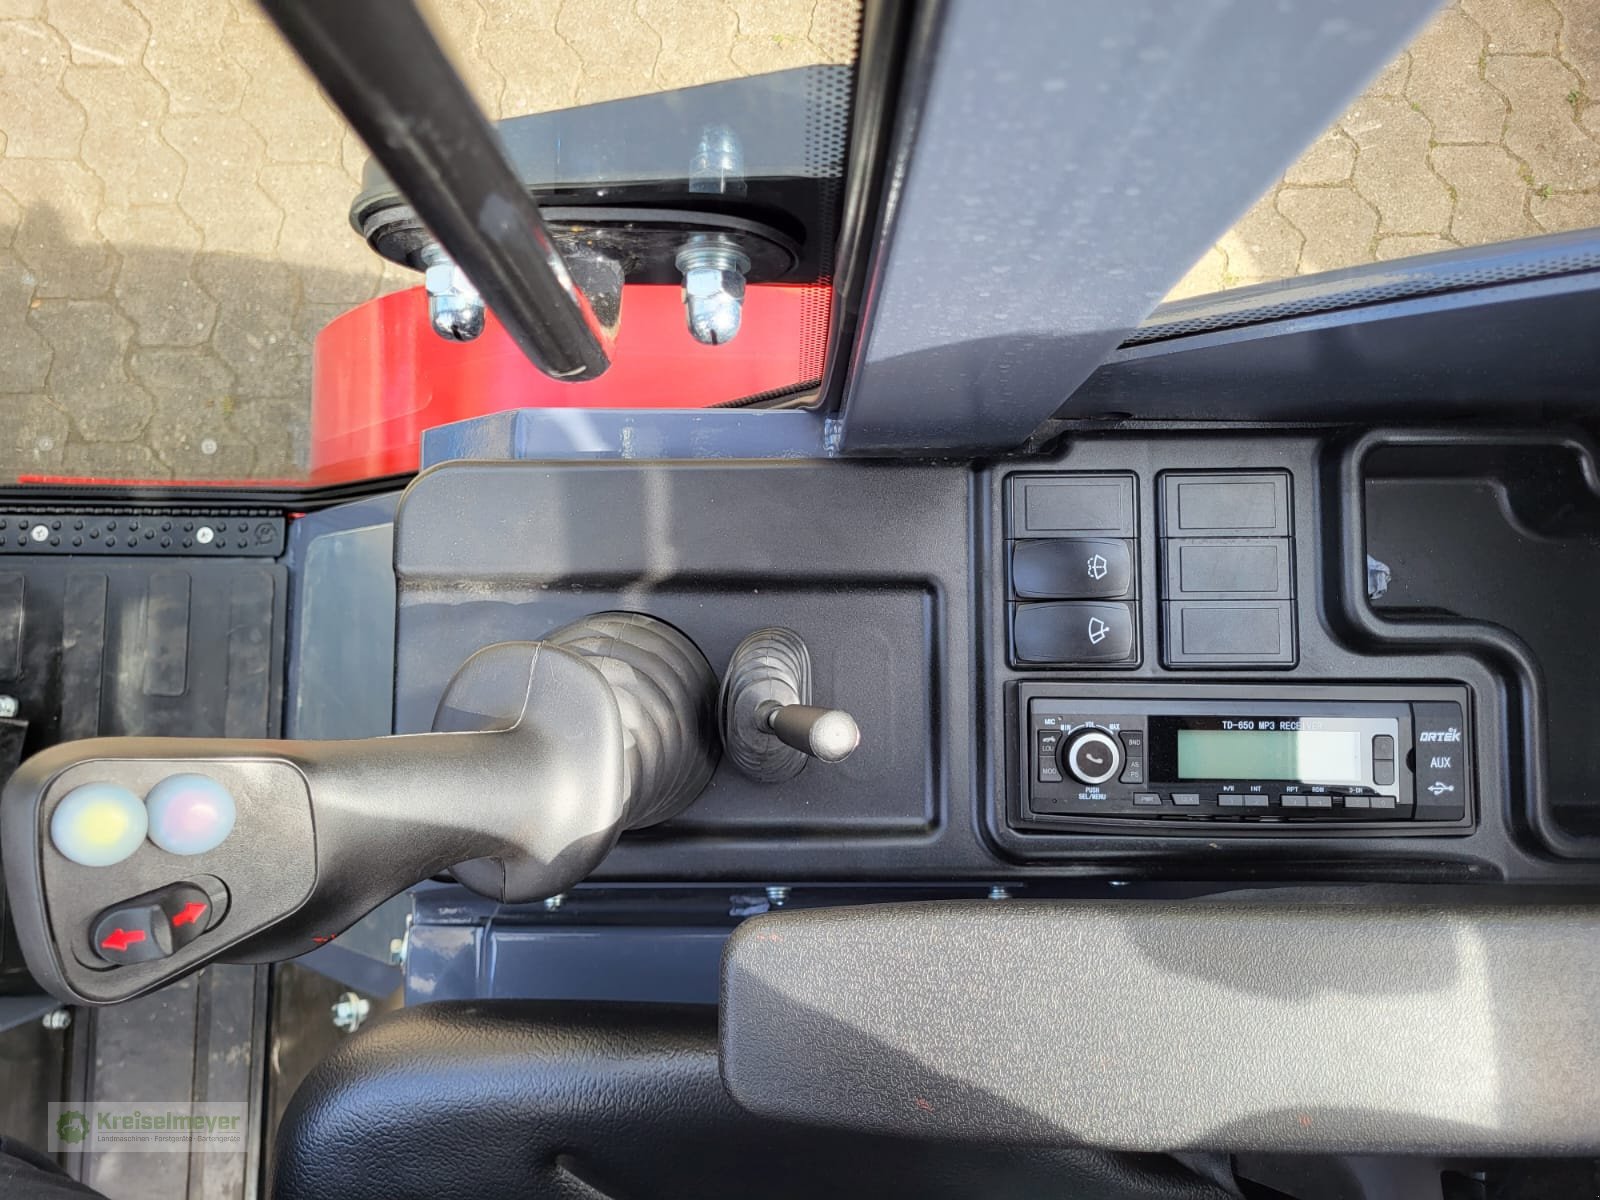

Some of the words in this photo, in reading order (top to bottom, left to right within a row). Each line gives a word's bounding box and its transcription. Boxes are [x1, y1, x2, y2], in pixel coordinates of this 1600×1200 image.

[1222, 720, 1254, 730] TD-650
[1258, 720, 1275, 730] MP3
[1430, 756, 1451, 768] AUX
